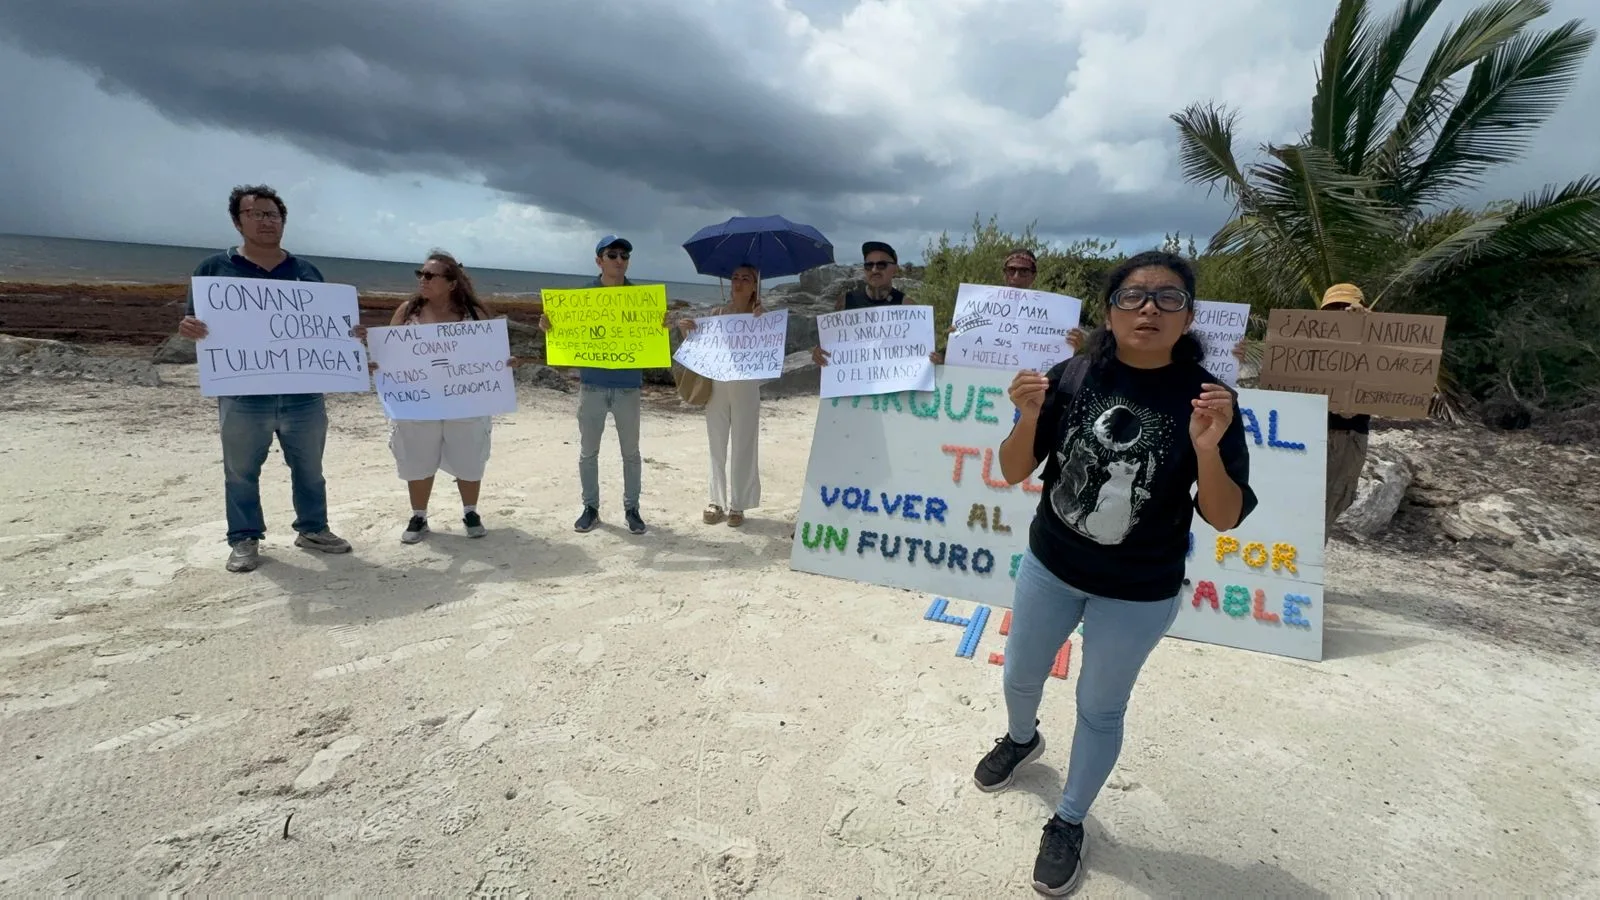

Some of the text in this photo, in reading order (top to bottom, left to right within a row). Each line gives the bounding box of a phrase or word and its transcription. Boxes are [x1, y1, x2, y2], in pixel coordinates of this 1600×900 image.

[208, 283, 313, 312] CONANP
[544, 292, 568, 308] POR
[997, 289, 1028, 301] FUERA
[864, 311, 880, 324] NO
[964, 300, 1048, 320] MUNDO MAYA
[269, 313, 354, 339] COBRA!
[589, 325, 607, 339] NO
[609, 326, 624, 338] SE
[725, 314, 783, 333] CONANP
[998, 322, 1019, 335] LOS
[384, 322, 493, 344] MAL PROGRAMA
[720, 333, 758, 350] MUNDO
[757, 332, 783, 348] MAYA
[838, 328, 850, 342] EL
[1367, 322, 1437, 345] NATURAL
[412, 340, 458, 356] CONANP
[624, 340, 644, 352] LOS
[883, 343, 927, 359] TURISMO
[974, 336, 1060, 354] A SUS TRENES
[205, 347, 362, 373] TULUM PAGA!
[574, 352, 636, 363] ACUERDOS
[962, 348, 1019, 366] Y HOTELES
[1269, 345, 1369, 373] PROTEGIDA
[382, 360, 505, 385] MENOS TURISMO
[837, 369, 846, 383] O
[851, 367, 864, 381] EL
[384, 381, 502, 403] MENOS ECONOMIA
[820, 485, 948, 522] VOLVER
[966, 503, 1011, 533] AL
[1215, 535, 1298, 574] POR
[801, 521, 848, 551] UN
[857, 530, 995, 574] FUTURO
